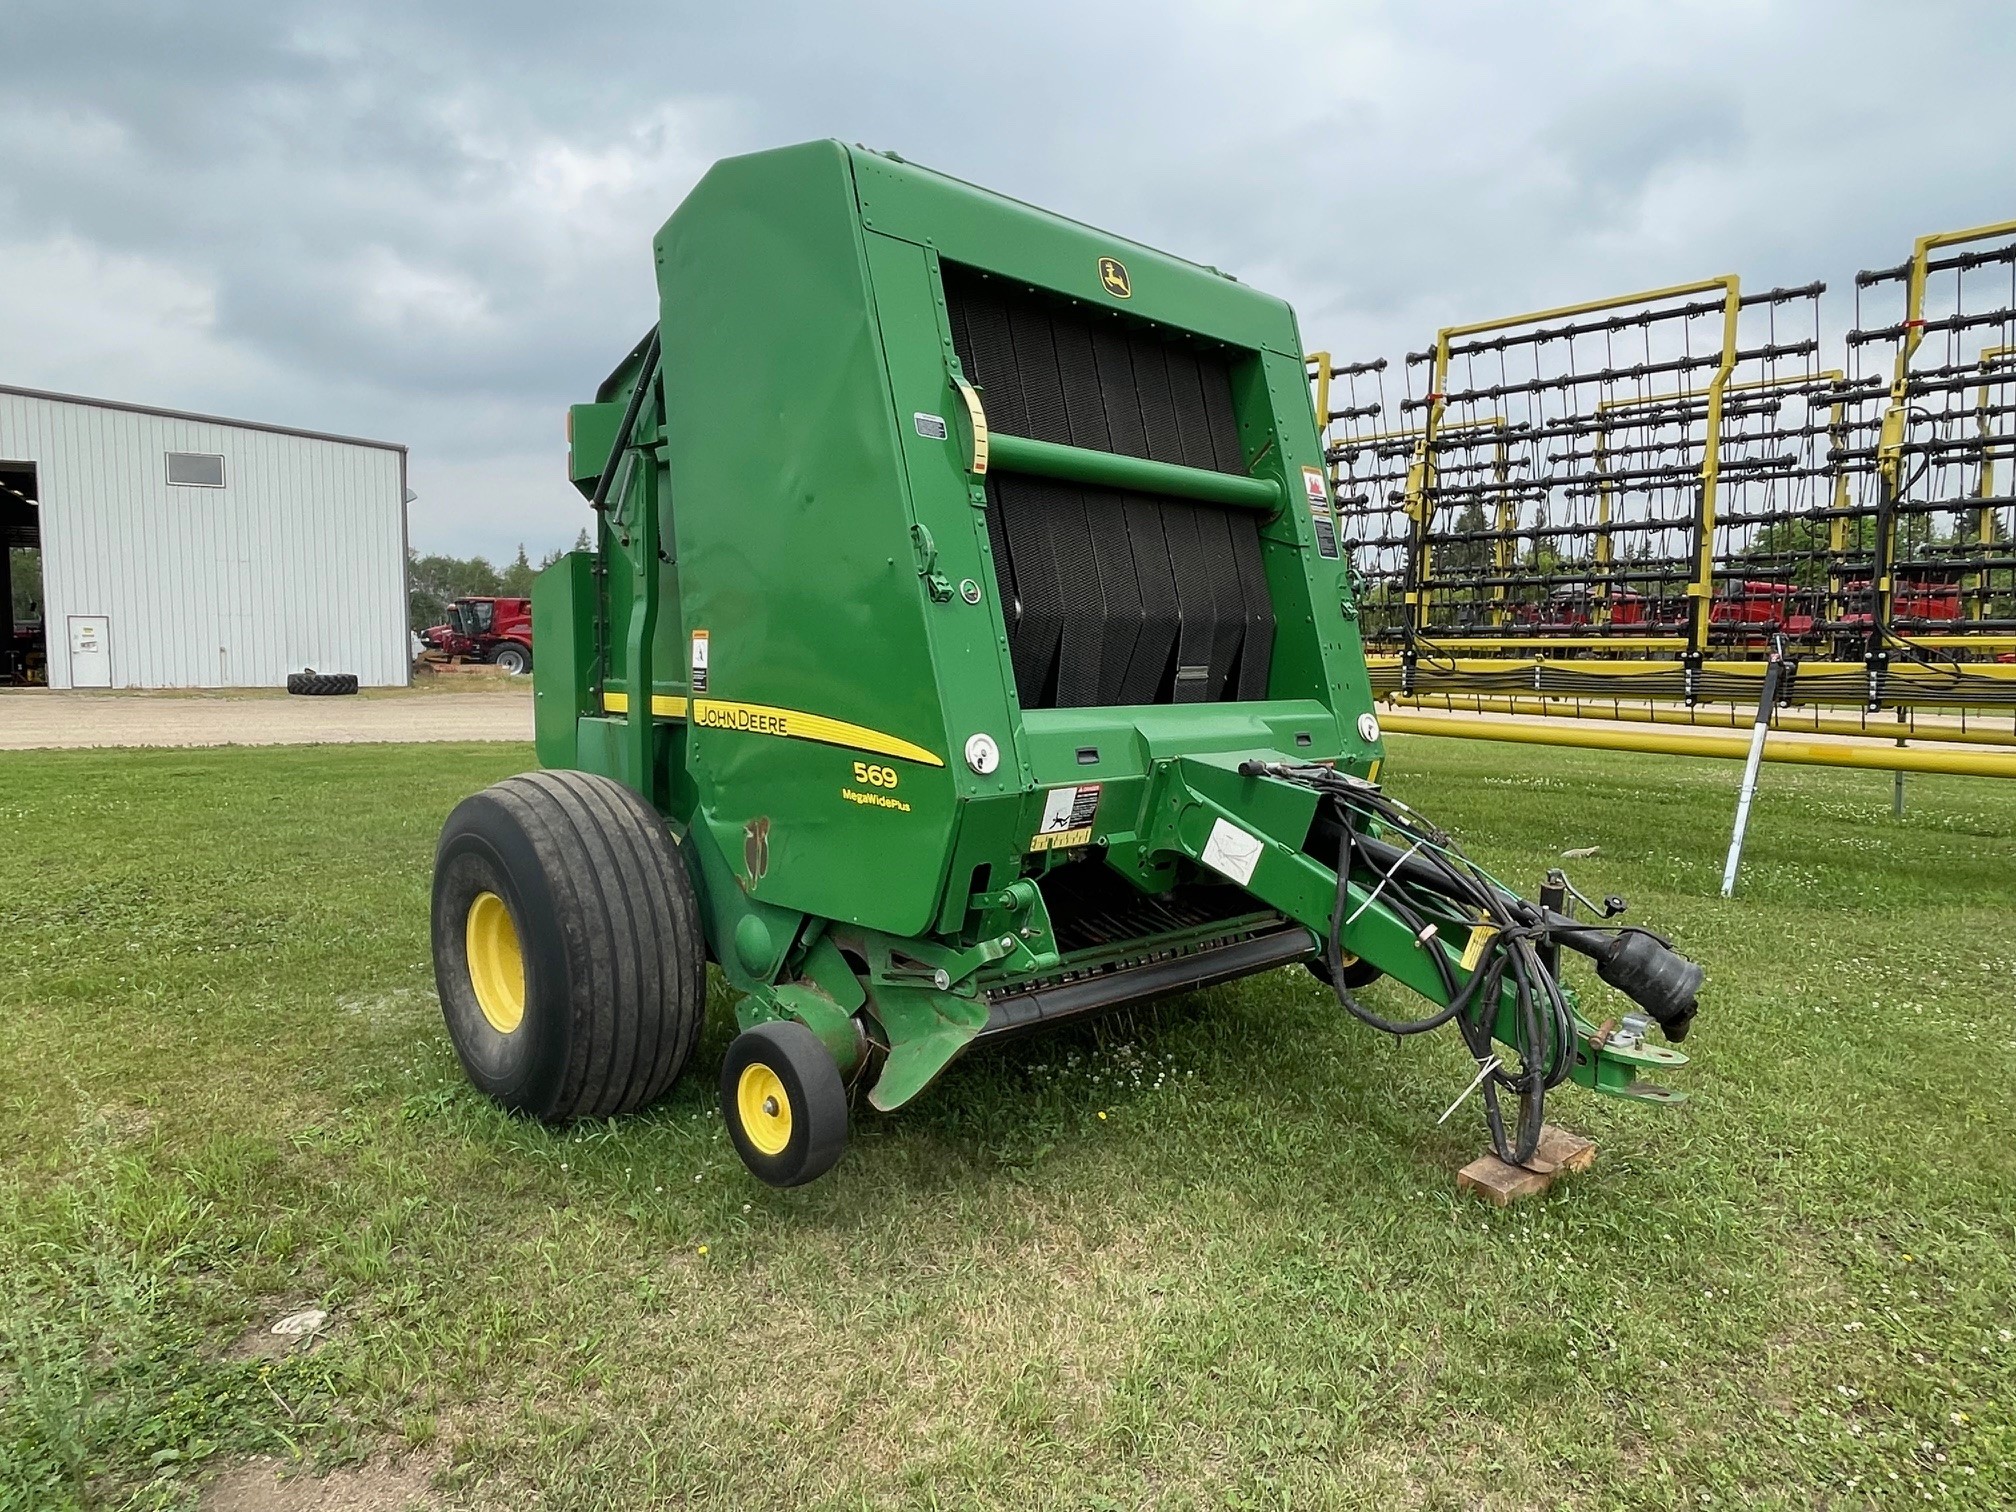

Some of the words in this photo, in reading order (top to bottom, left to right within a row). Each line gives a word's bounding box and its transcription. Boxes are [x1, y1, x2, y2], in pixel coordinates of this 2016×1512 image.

[701, 706, 736, 727] JOHN
[739, 709, 788, 733] DEERE
[853, 761, 898, 789] 569
[842, 788, 911, 812] MegaWidePlus
